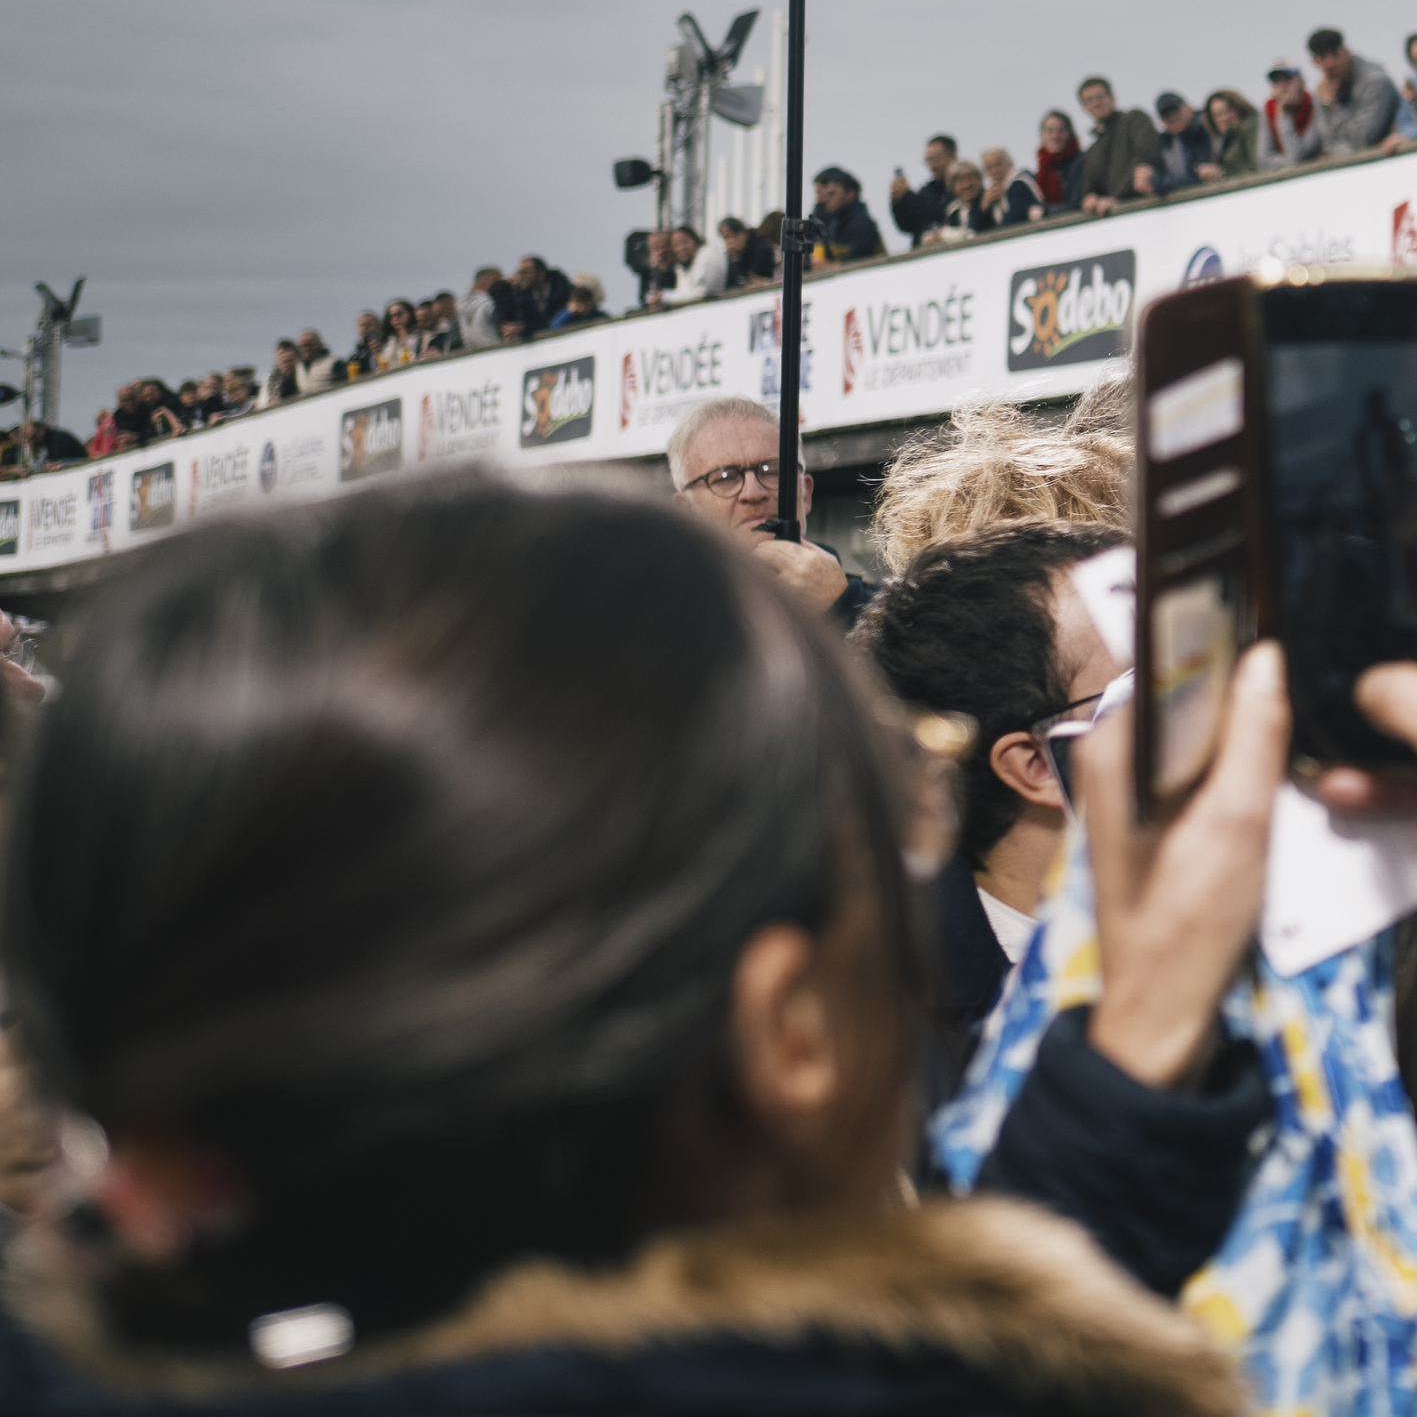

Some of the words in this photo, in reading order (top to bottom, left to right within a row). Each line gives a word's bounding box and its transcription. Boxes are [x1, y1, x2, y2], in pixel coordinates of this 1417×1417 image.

[866, 282, 974, 356] VENDÉE
[1010, 264, 1131, 357] Sodebo
[640, 333, 722, 396] VENDÉE
